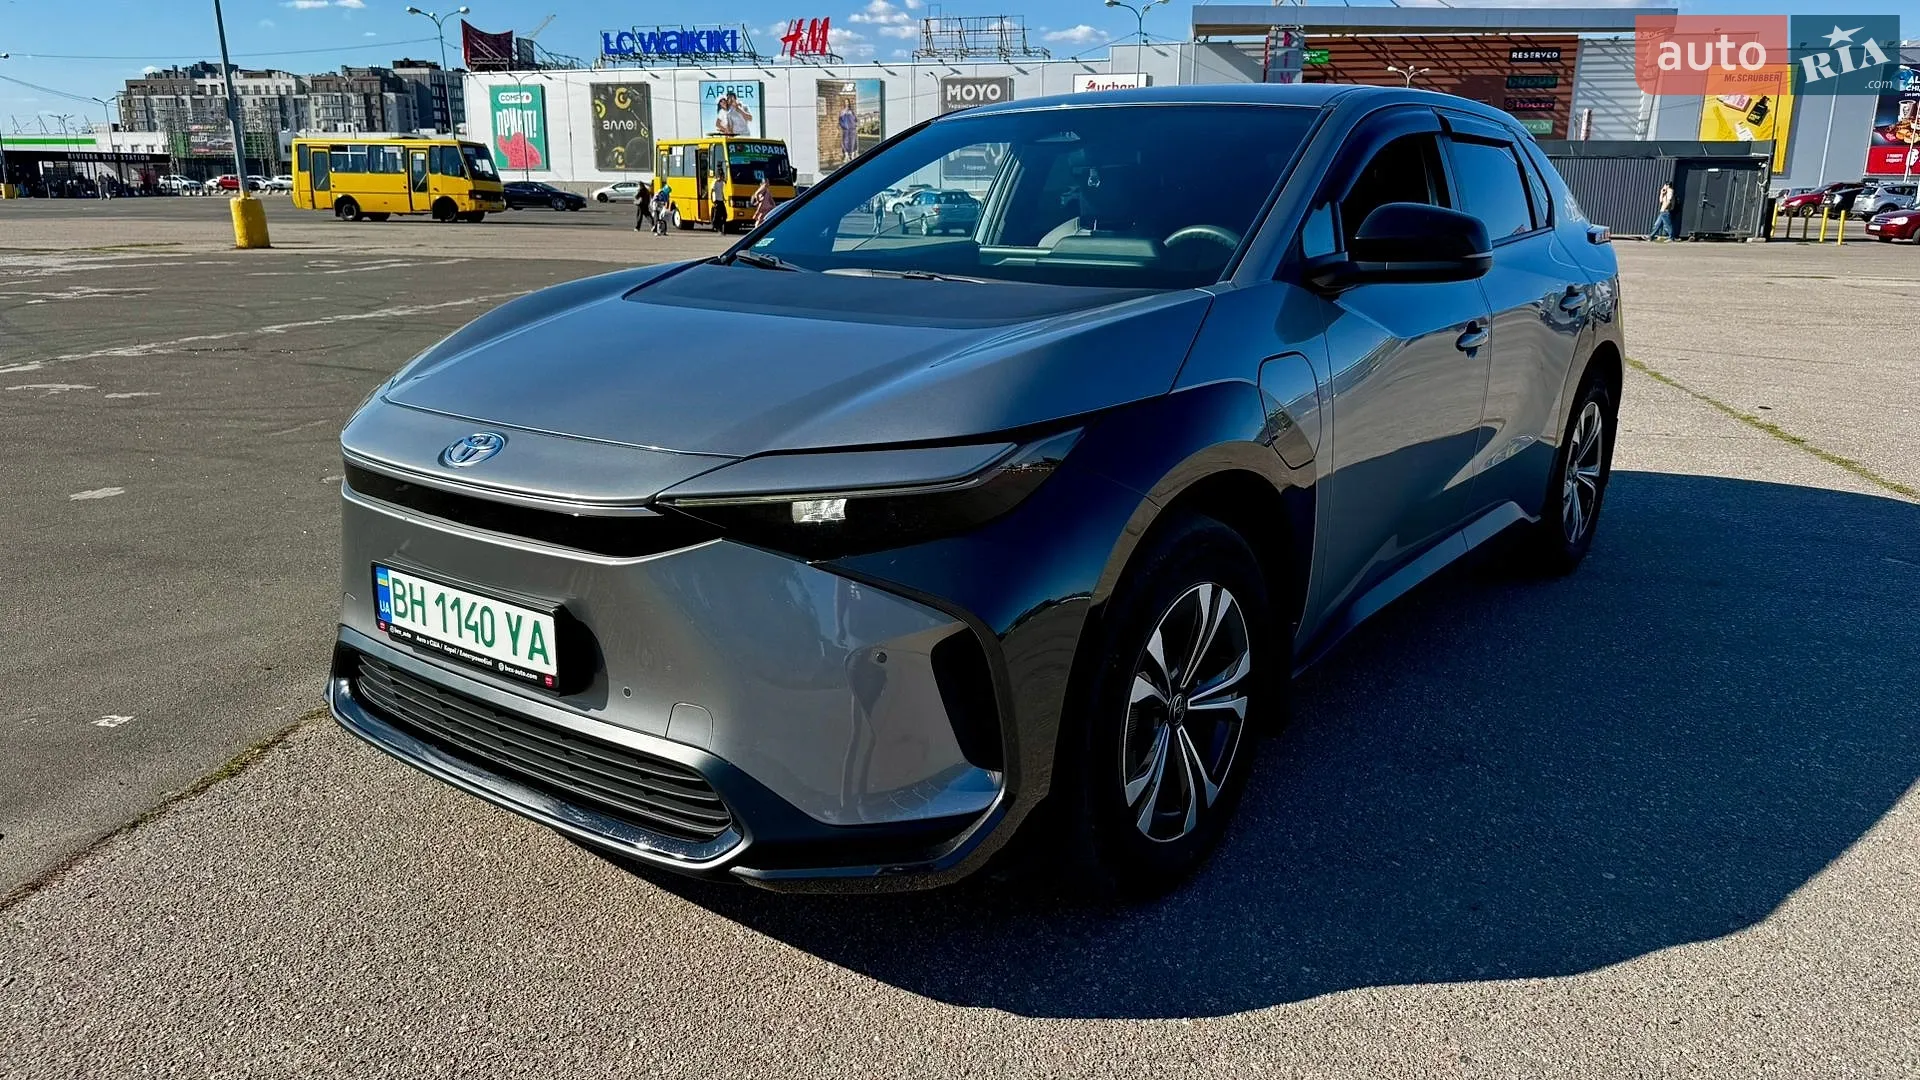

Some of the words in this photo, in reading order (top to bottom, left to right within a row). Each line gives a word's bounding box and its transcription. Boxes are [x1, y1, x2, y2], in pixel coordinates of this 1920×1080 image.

[947, 84, 1001, 101] MOYO
[380, 600, 391, 614] UA
[391, 577, 427, 626] BH
[435, 592, 496, 648] 1140
[505, 611, 550, 665] YA
